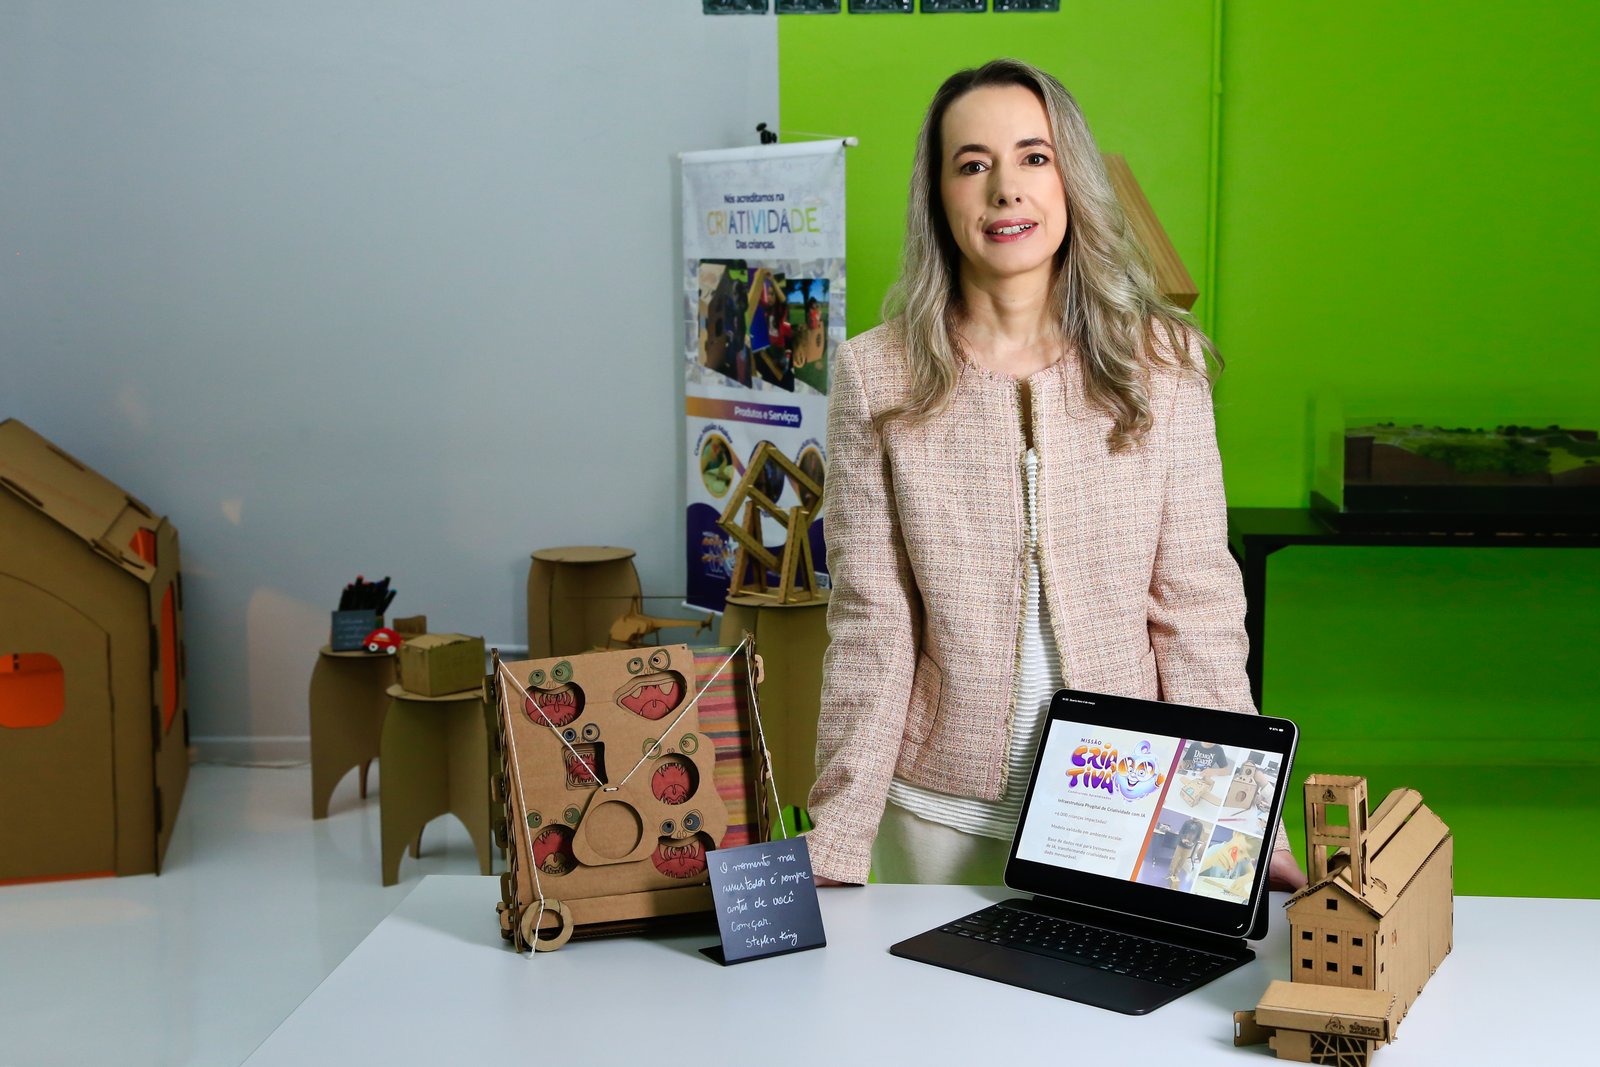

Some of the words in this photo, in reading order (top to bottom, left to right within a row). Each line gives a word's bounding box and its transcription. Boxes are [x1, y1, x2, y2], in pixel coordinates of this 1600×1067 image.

[724, 193, 735, 203] Nós
[736, 192, 774, 203] acreditamos
[776, 193, 785, 202] na
[706, 207, 820, 236] CRIATIVIDADE
[736, 239, 747, 249] Das
[734, 406, 763, 420] Produtos
[763, 411, 769, 420] e
[769, 410, 799, 424] Serviços
[1081, 738, 1102, 746] MISSÃO
[1058, 798, 1084, 807] Infraestrutura
[1107, 806, 1131, 815] Criatividade
[720, 862, 728, 874] O
[733, 853, 771, 871] momento
[777, 848, 796, 862] mais
[770, 872, 778, 885] é
[727, 898, 748, 914] antes
[754, 896, 768, 909] de
[772, 890, 794, 906] você
[779, 929, 798, 947] King
